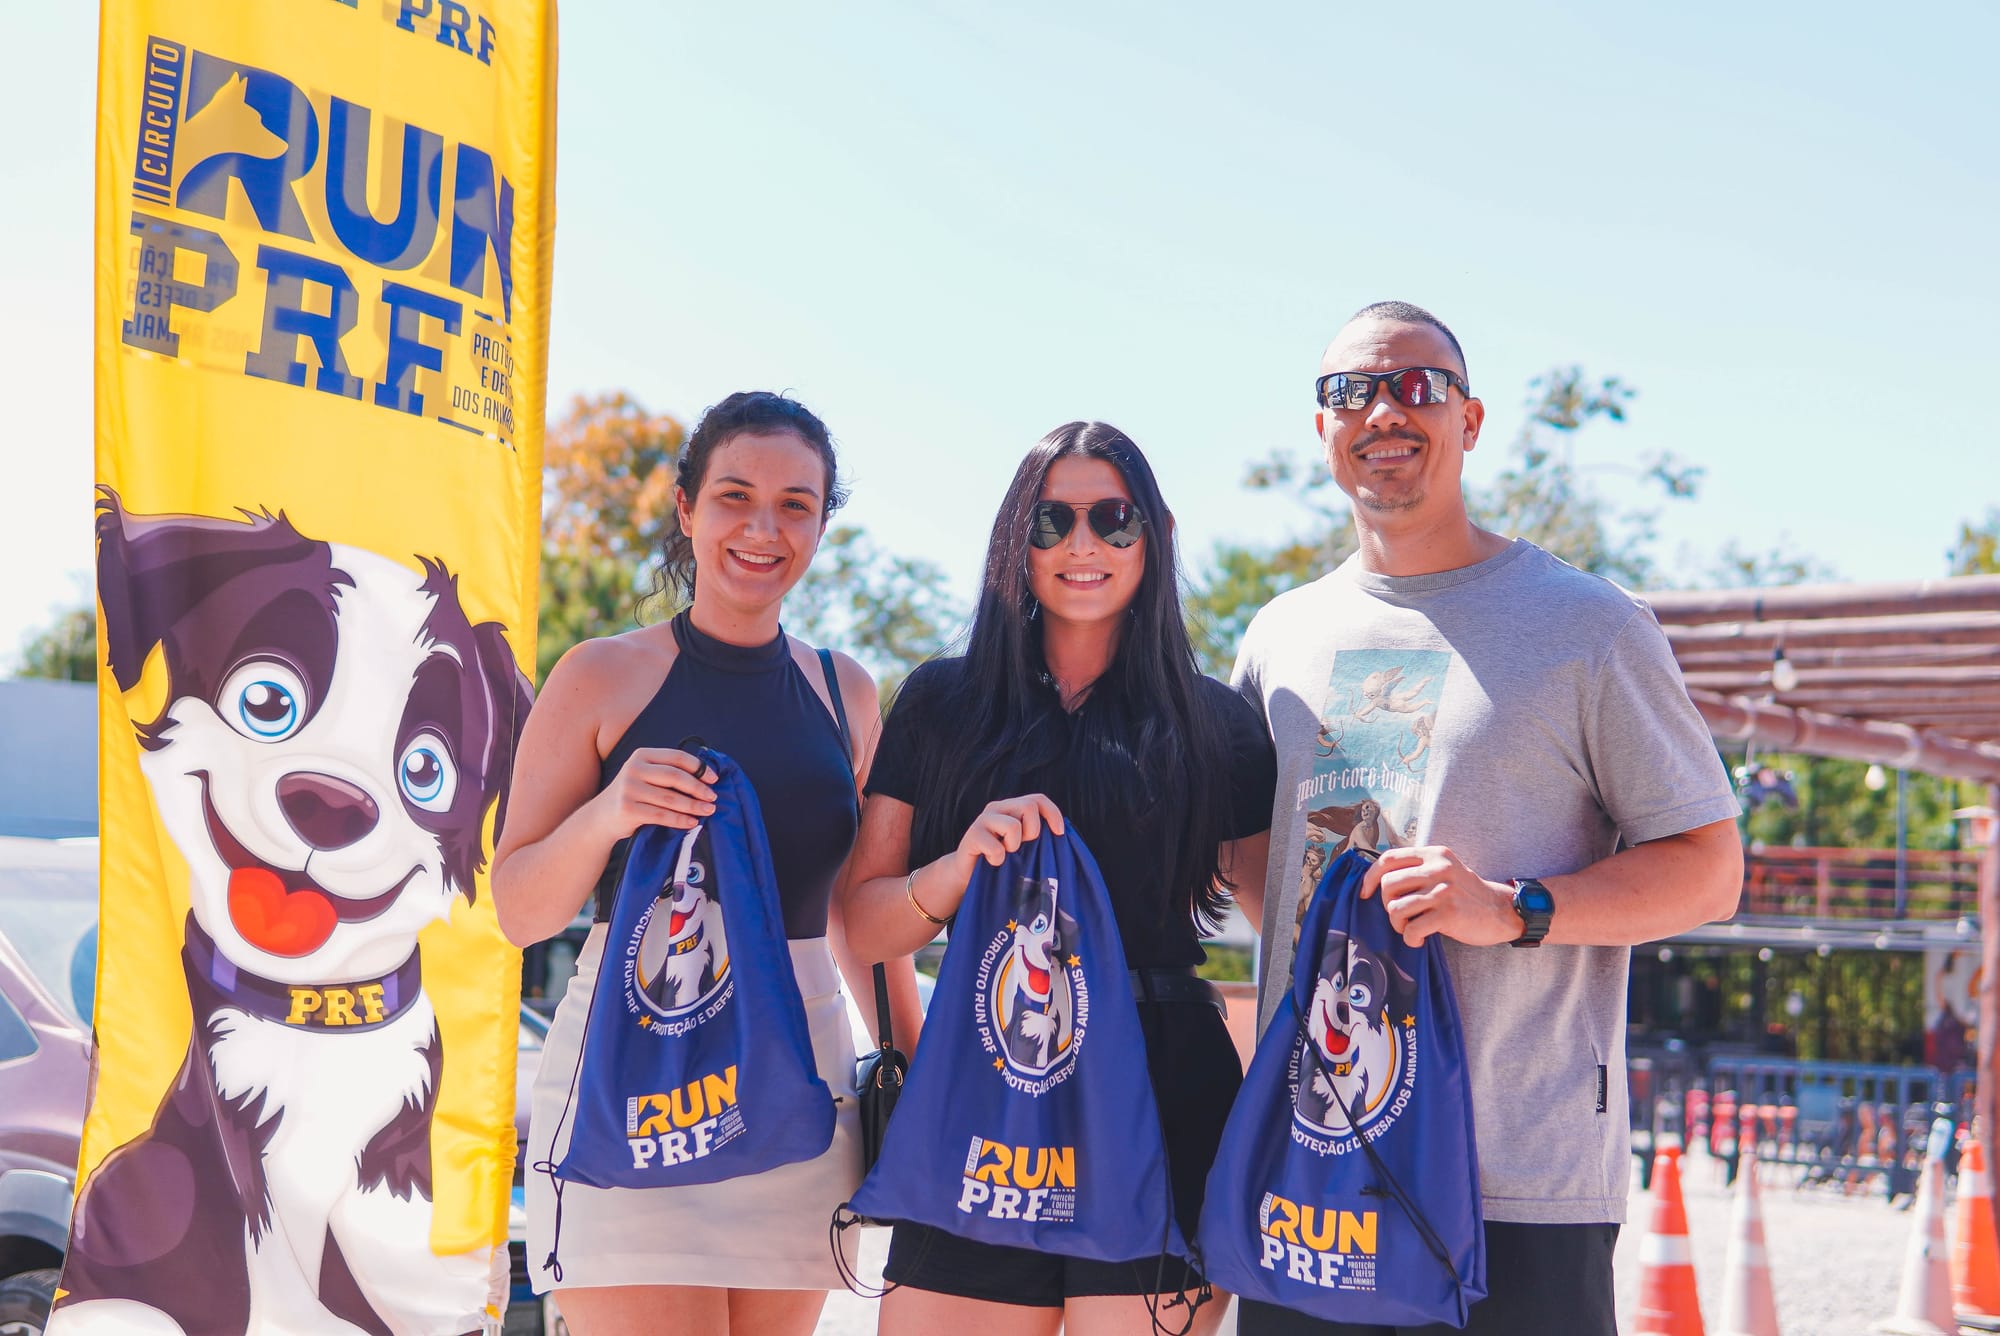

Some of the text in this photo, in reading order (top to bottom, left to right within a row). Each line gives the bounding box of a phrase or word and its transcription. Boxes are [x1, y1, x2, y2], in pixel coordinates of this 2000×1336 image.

[396, 0, 497, 67] PRF
[141, 43, 180, 177] CIRCUITO
[176, 49, 515, 325] RUN
[121, 211, 463, 417] PRF
[452, 385, 480, 415] DOS
[481, 366, 489, 388] E
[624, 960, 635, 988] RUN
[975, 929, 1009, 1054] CIRCUITO RUN PRF
[1071, 968, 1089, 1027] ANIMAIS
[285, 983, 384, 1025] PRF
[624, 991, 640, 1014] PRF
[698, 1012, 707, 1025] E
[705, 980, 735, 1019] DEFE
[1073, 1027, 1086, 1055] DOS
[1288, 1050, 1300, 1080] RUN
[638, 1064, 737, 1137] RUN
[1001, 1066, 1046, 1098] PROTEÇ
[1344, 1142, 1352, 1153] E
[1352, 1116, 1396, 1150] DFESA
[1391, 1088, 1412, 1119] DOS
[1404, 1028, 1416, 1089] ANIMAIS
[628, 1117, 718, 1169] PRF
[975, 1140, 1075, 1189] RUN
[957, 1176, 1049, 1222] PRF
[1269, 1195, 1377, 1254] RUN
[1260, 1233, 1344, 1288] PRF
